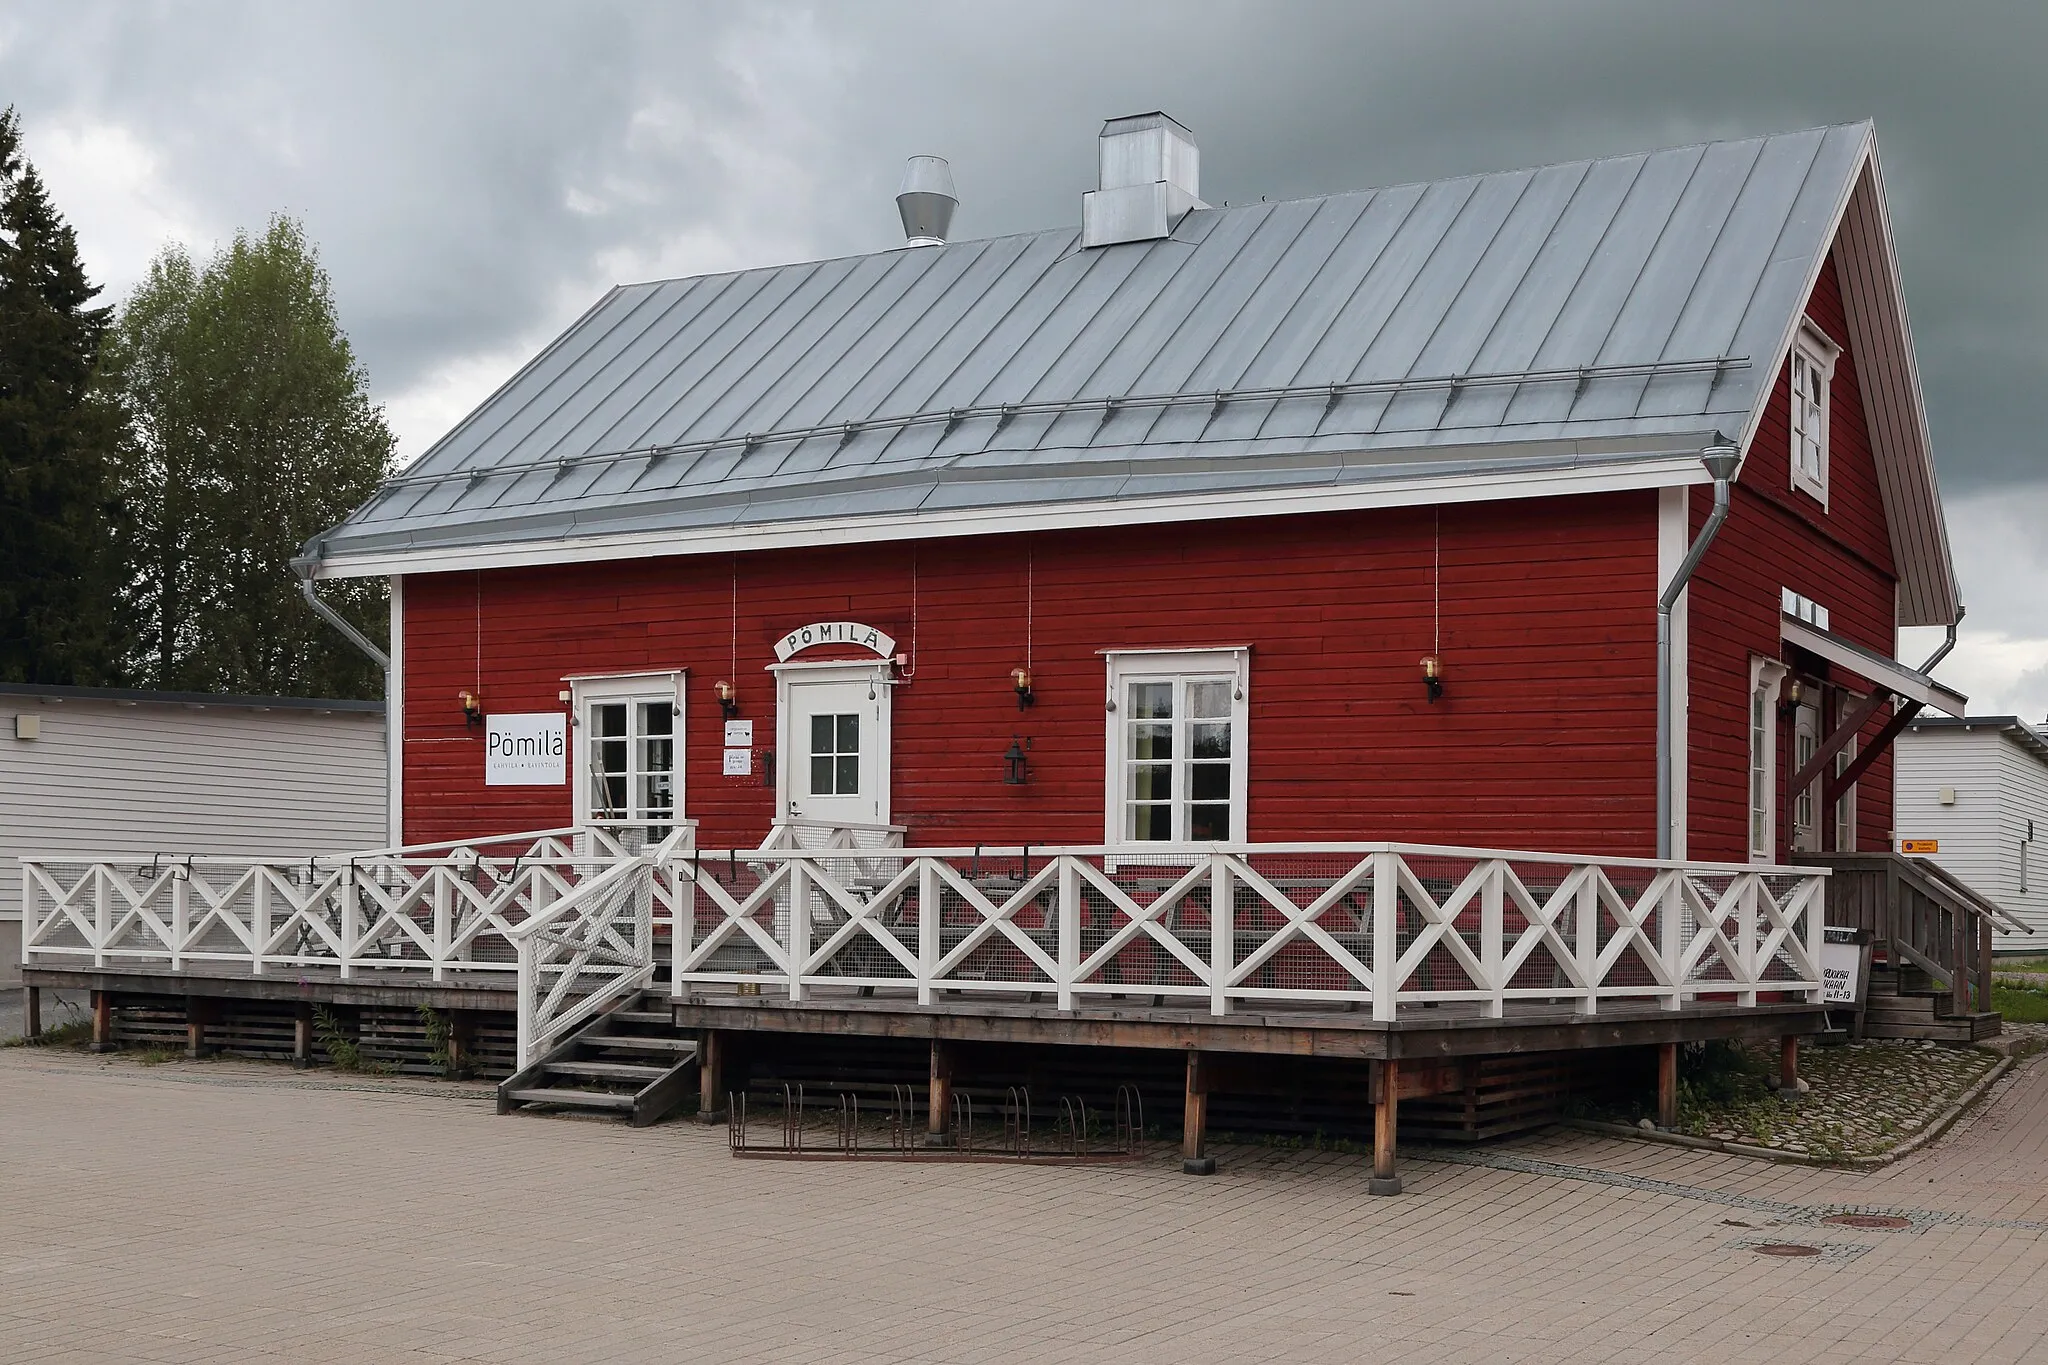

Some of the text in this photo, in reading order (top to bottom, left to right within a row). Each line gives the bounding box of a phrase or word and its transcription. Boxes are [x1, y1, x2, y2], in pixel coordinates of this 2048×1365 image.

[786, 624, 879, 651] PÖMILÄ
[489, 730, 563, 756] Pömilä
[1833, 990, 1851, 999] 11-13
